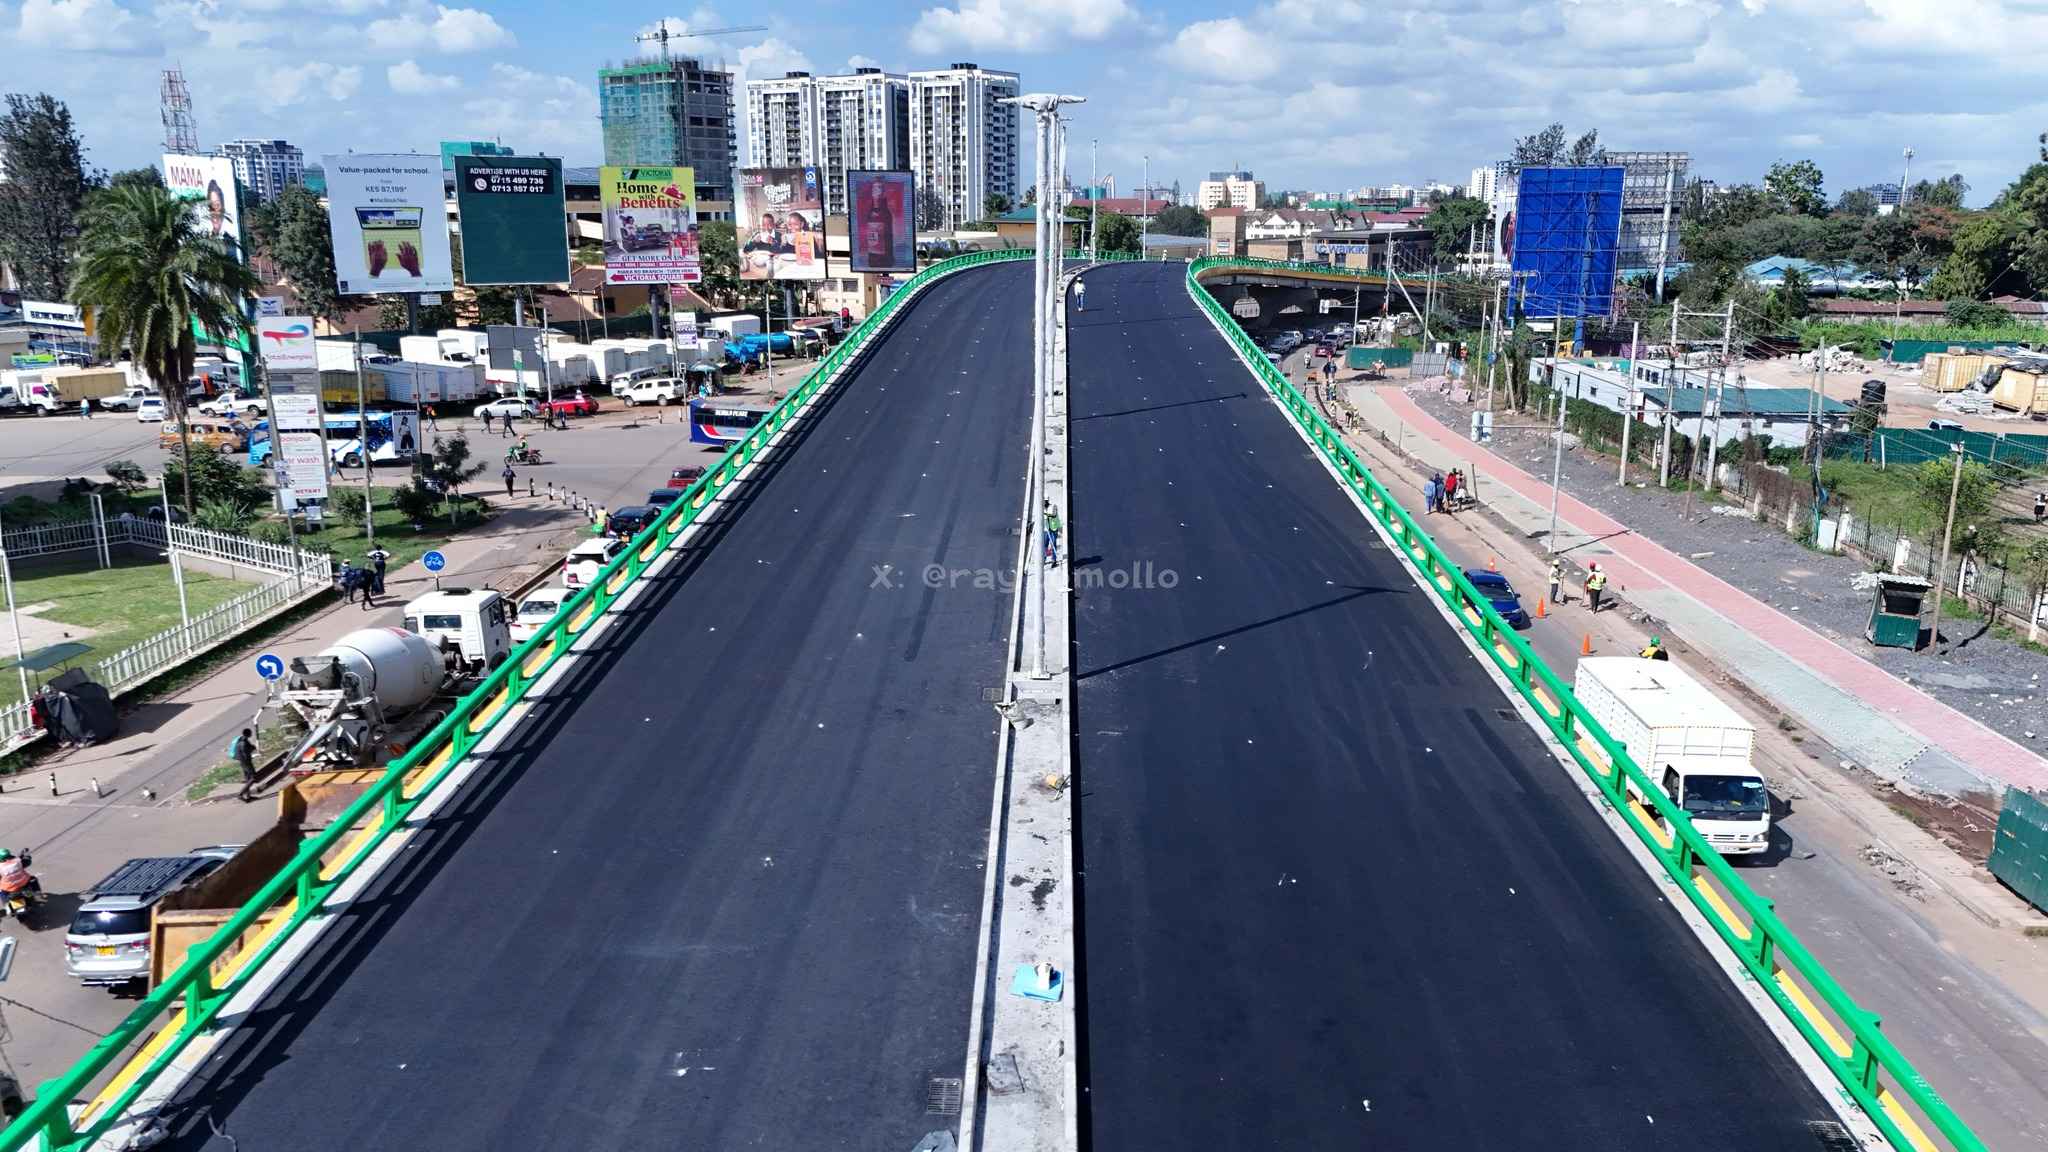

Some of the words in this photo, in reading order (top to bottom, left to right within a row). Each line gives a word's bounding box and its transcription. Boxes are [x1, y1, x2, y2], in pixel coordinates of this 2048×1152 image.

[339, 166, 390, 175] Value-packed
[470, 167, 503, 175] ADVERTISE
[170, 166, 204, 187] MAMA
[491, 176, 511, 184] 0715
[491, 185, 511, 193] 0713
[616, 182, 658, 194] Home
[620, 195, 681, 209] Benefits
[657, 273, 685, 281] SQUARE
